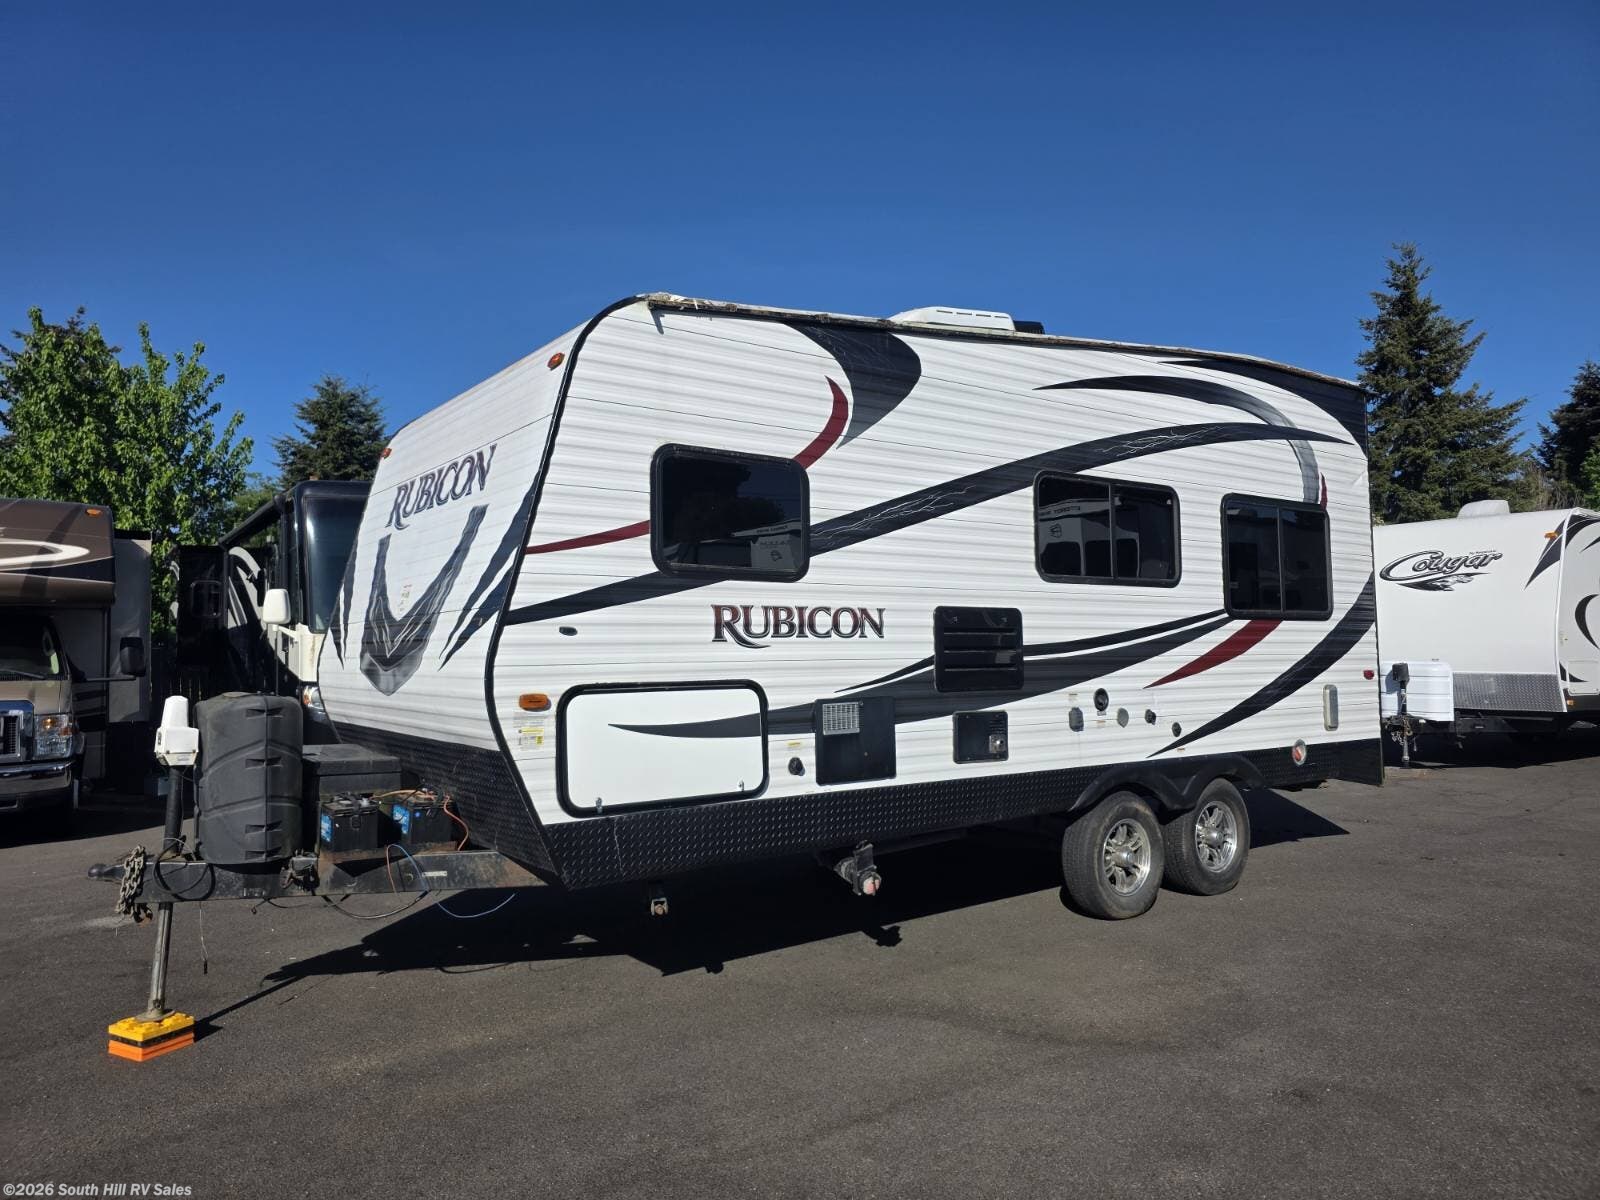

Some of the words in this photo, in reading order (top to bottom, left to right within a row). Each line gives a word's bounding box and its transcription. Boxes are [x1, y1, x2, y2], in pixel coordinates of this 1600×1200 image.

[385, 443, 497, 530] RUBICON
[1379, 550, 1503, 581] Cougar
[711, 604, 886, 649] RUBICON
